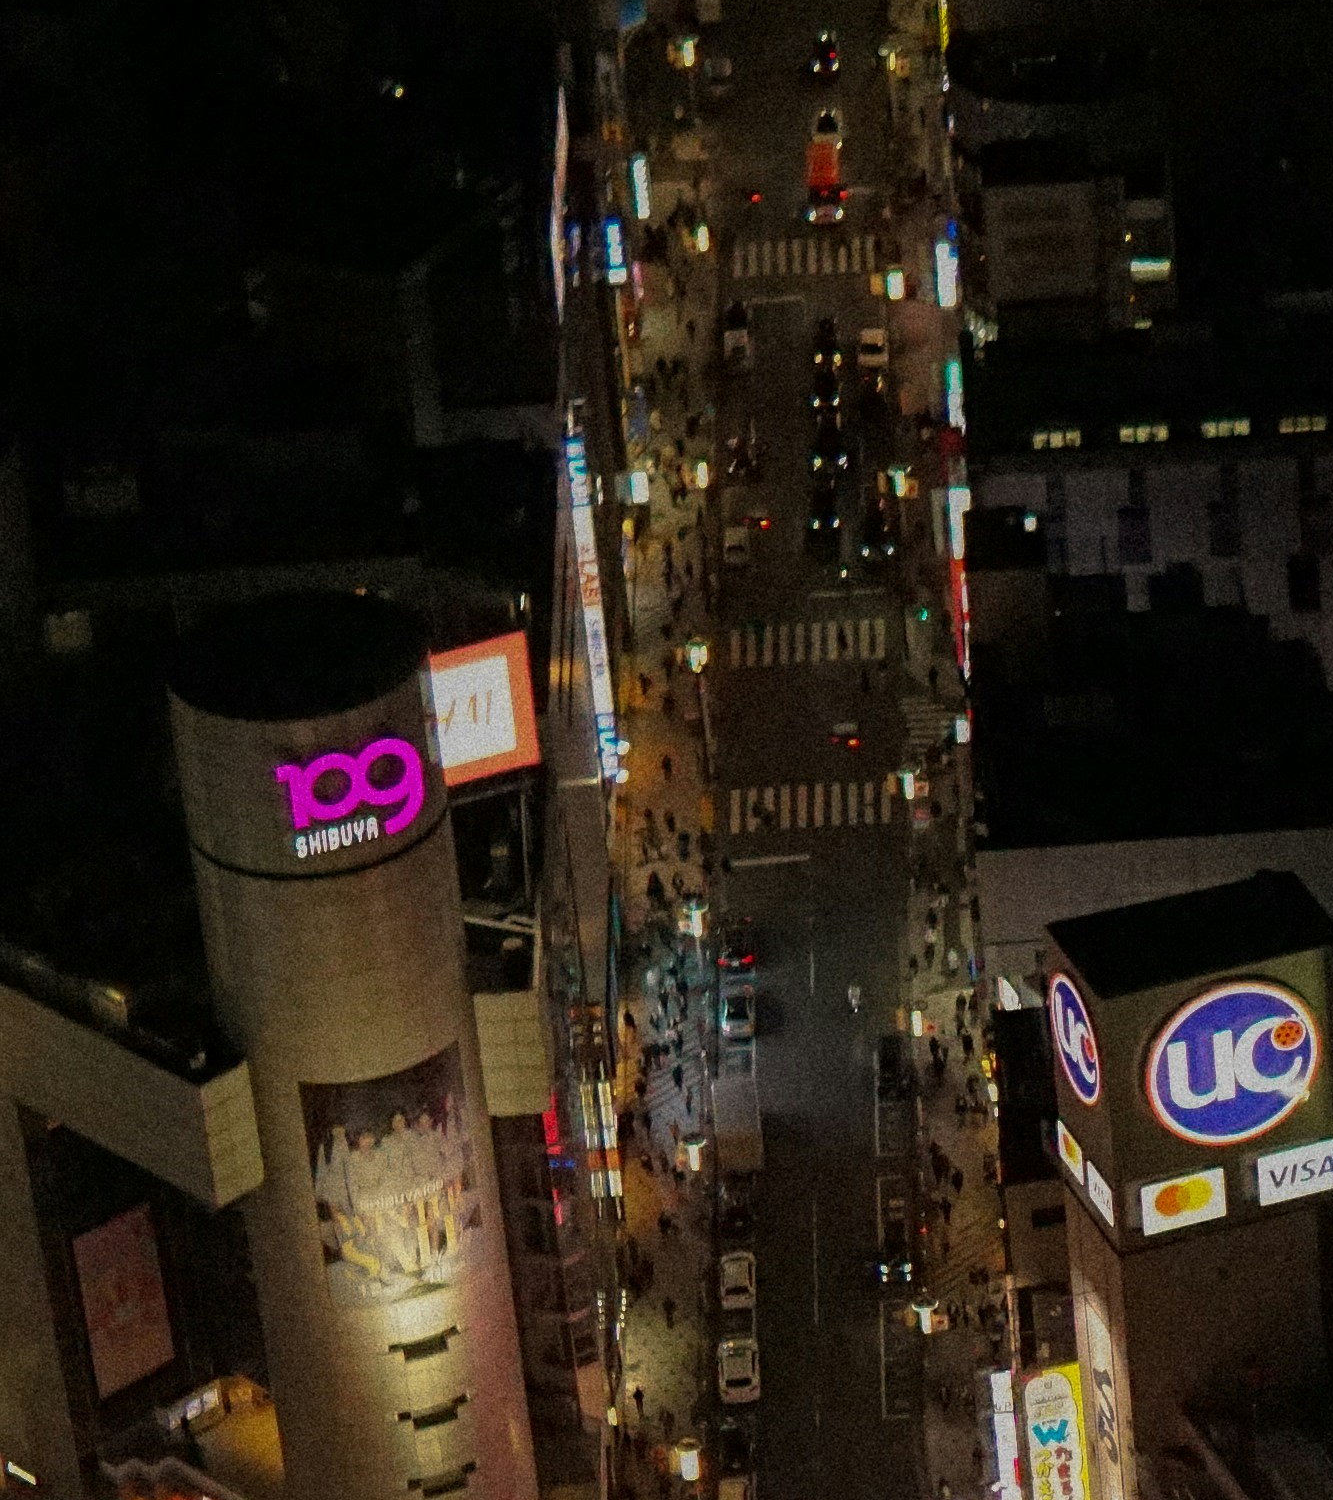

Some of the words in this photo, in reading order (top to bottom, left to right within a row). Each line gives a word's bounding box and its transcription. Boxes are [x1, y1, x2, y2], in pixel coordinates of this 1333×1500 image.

[273, 736, 427, 836] 109
[295, 816, 381, 859] SHIBUYA
[1056, 989, 1097, 1086] UC
[1165, 1015, 1306, 1111] UC
